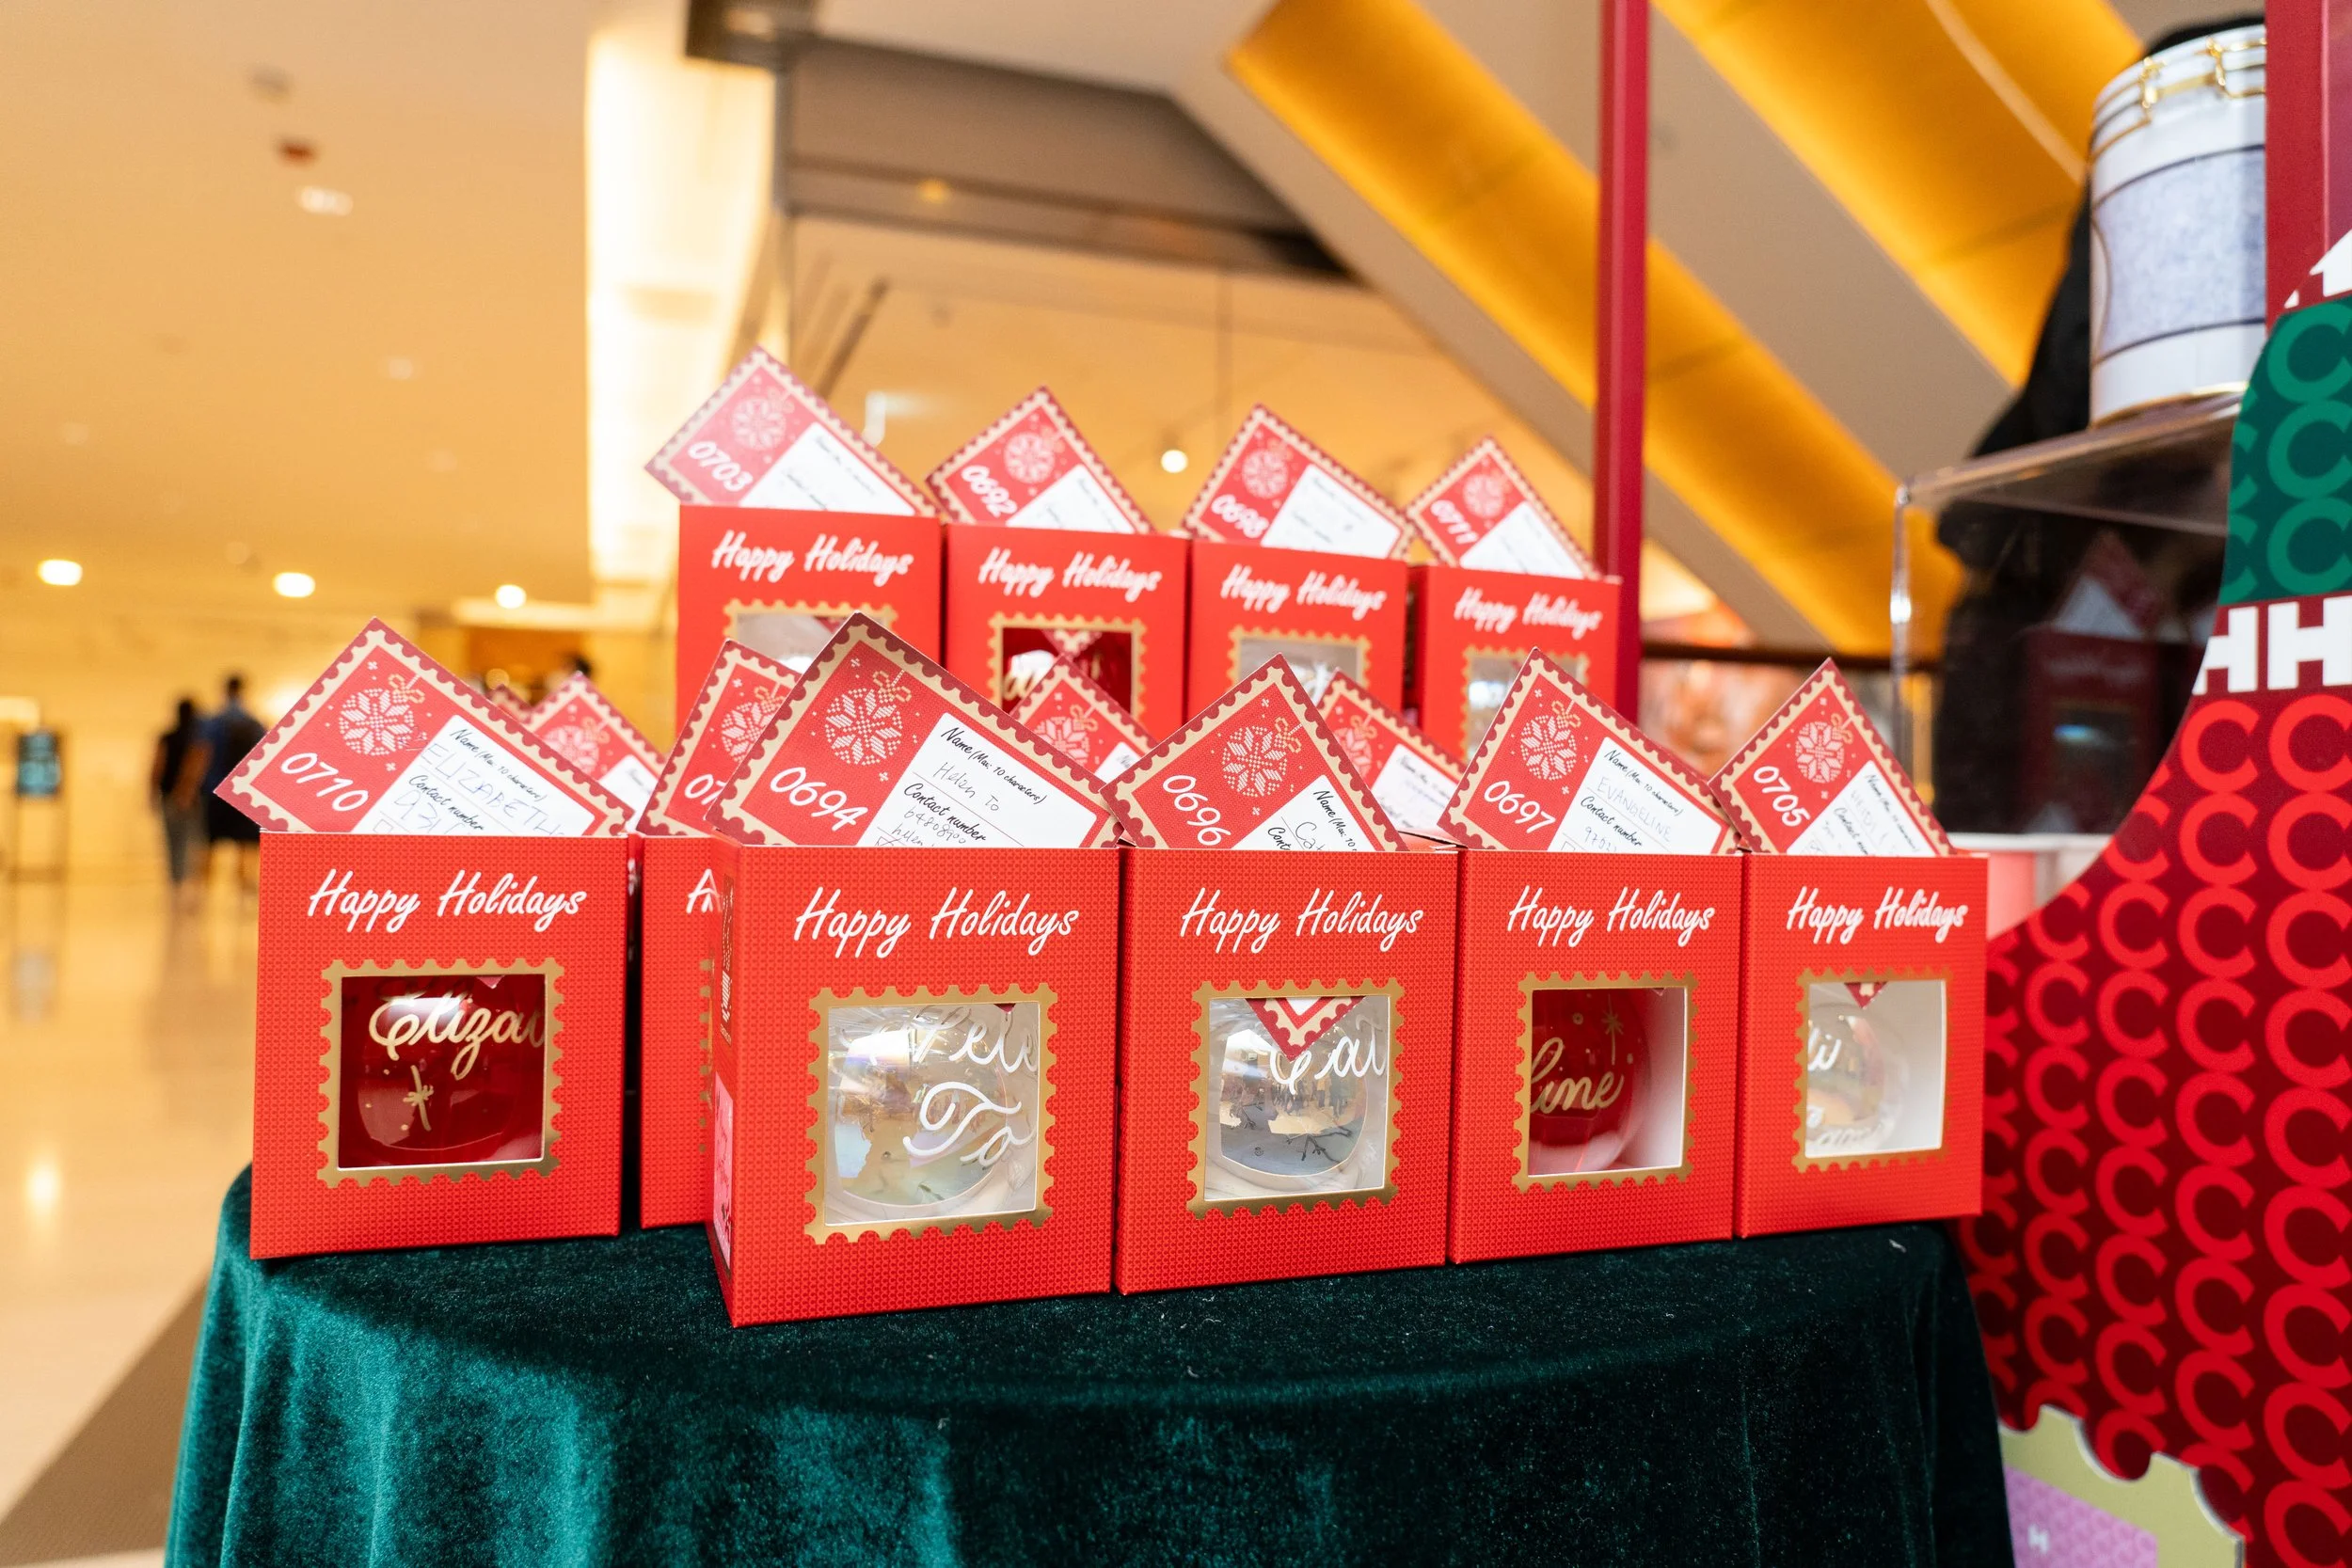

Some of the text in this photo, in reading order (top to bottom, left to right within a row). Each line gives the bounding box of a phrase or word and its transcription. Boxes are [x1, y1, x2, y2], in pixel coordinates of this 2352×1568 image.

[688, 440, 753, 492] 0703
[961, 465, 1018, 517] 0692
[711, 530, 914, 587] Happy Holidays
[978, 547, 1162, 602] Happy Holidays
[1220, 564, 1386, 620] Happy Holidays
[1454, 587, 1601, 640] Happy Holidays
[450, 728, 481, 753] Name
[941, 727, 973, 754] Name
[993, 767, 1006, 777] 10
[1003, 775, 1048, 805] characters)
[1604, 750, 1628, 771] Name
[281, 752, 369, 812] 0710
[409, 775, 484, 832] Contact number
[770, 767, 868, 832] 0694
[932, 762, 977, 799] Helen
[1484, 780, 1556, 833] 0697
[1754, 766, 1811, 828] 0705
[903, 783, 988, 842] Contact number
[1163, 775, 1231, 846] 0696
[1313, 791, 1337, 818] Name
[1345, 838, 1356, 847] 10
[1581, 796, 1643, 847] Contact number
[308, 869, 587, 933] Happy Holidays
[794, 887, 911, 958] Happy
[930, 887, 1079, 956] Holidays
[1181, 888, 1423, 954] Happy Holidays
[1507, 885, 1715, 947] Happy Holidays
[1787, 886, 1968, 944] Happy Holidays
